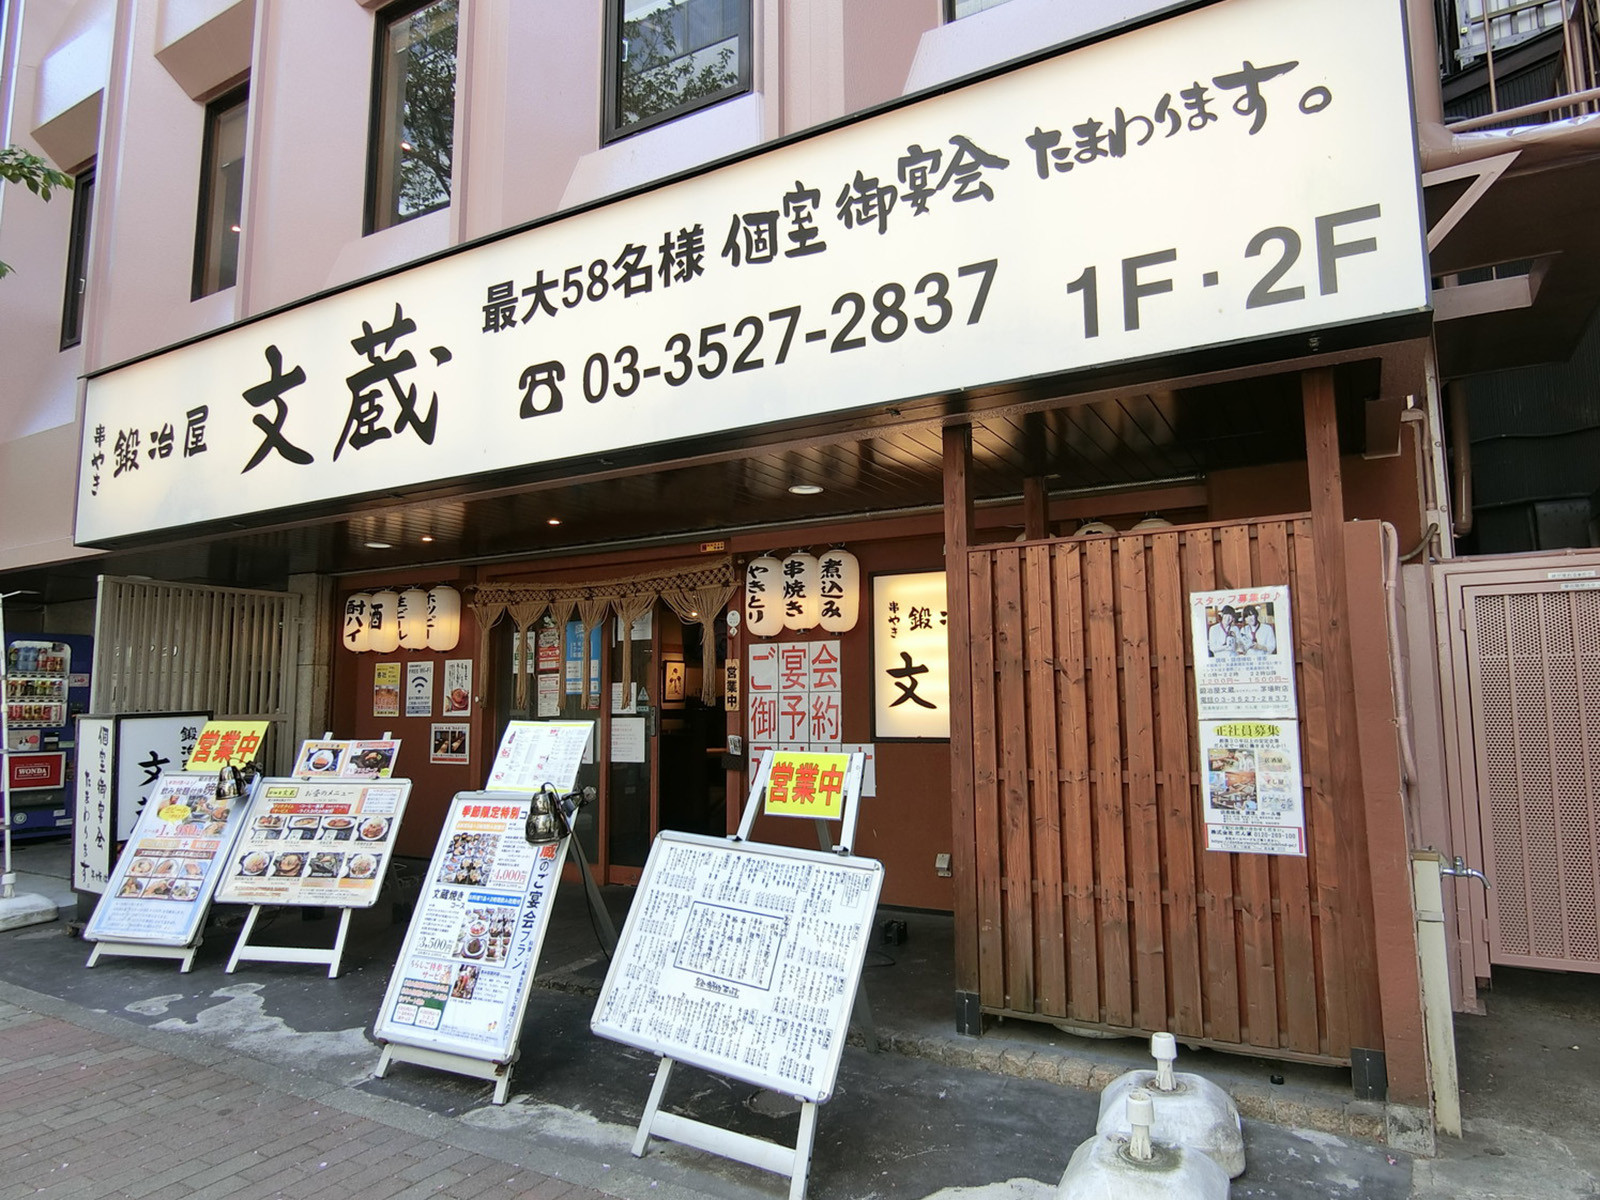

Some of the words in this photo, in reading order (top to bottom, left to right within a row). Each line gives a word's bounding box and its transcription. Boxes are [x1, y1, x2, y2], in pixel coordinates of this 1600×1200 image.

[582, 258, 998, 404] 03-3527-2837
[241, 302, 453, 475] 文蔵
[91, 423, 106, 496] 串やき
[113, 404, 209, 479] 鍛冶屋
[748, 565, 769, 624] やきとり
[783, 560, 805, 617] 串焼き
[820, 558, 844, 618] 煮込み
[908, 606, 948, 631] 鍛
[726, 666, 738, 707] 営業中
[751, 644, 839, 690] ご宴会
[751, 695, 840, 740] 御予約
[1216, 725, 1280, 737] 正社員募集
[192, 730, 260, 763] 営業中
[18, 768, 47, 776] WONDA
[768, 761, 845, 806] 営業中
